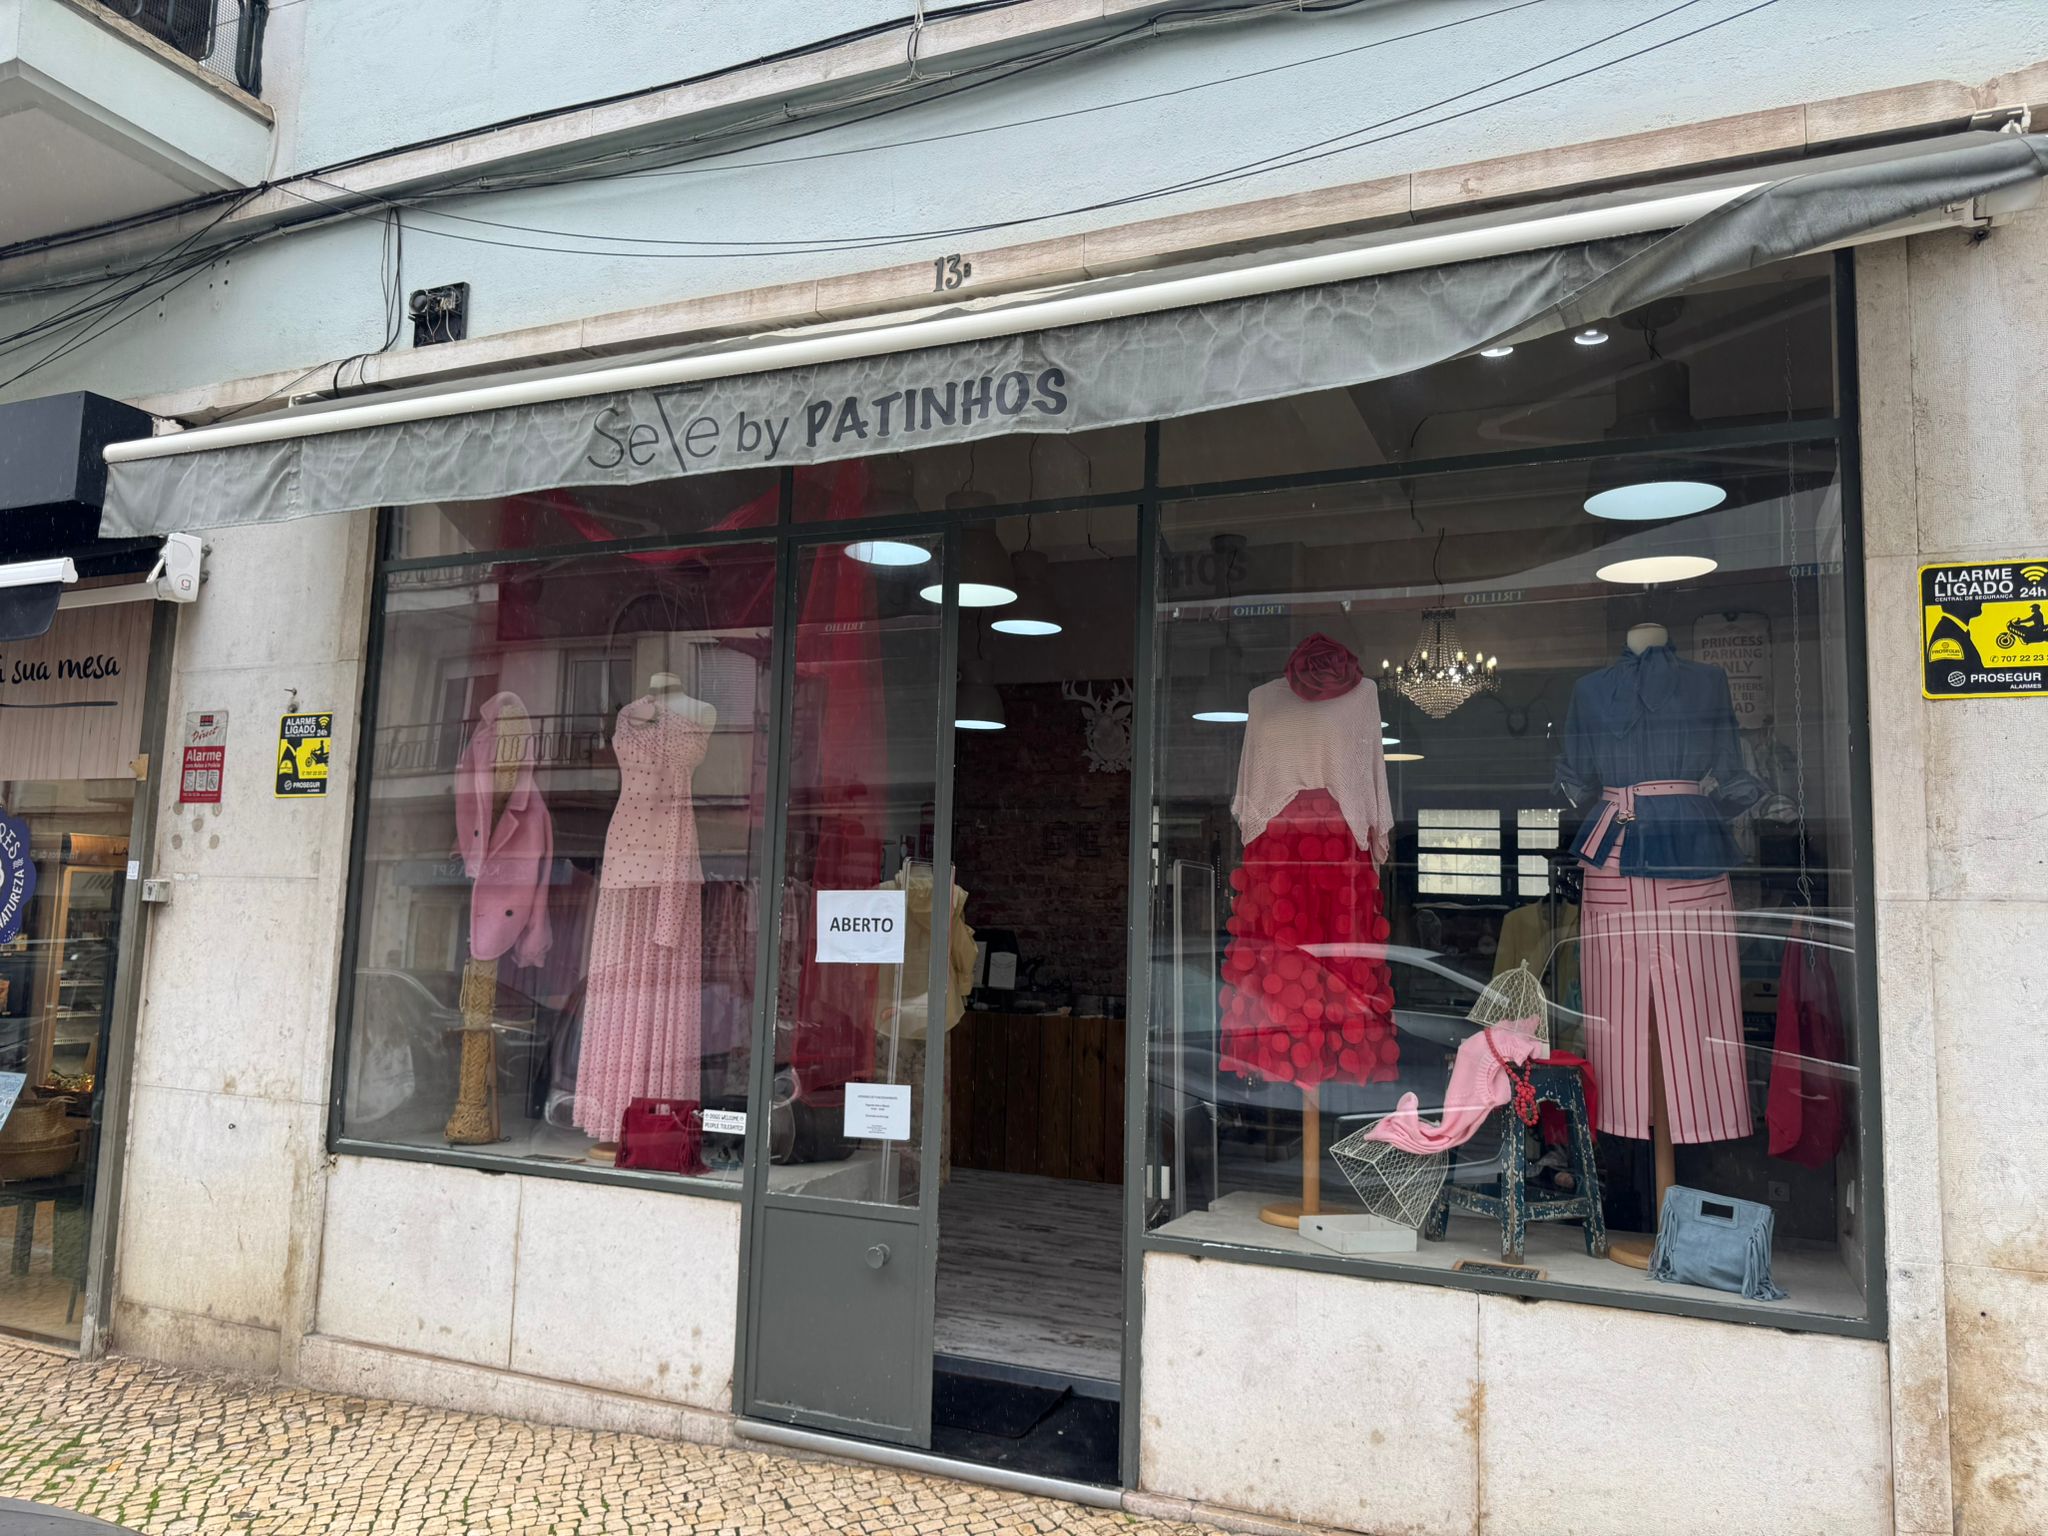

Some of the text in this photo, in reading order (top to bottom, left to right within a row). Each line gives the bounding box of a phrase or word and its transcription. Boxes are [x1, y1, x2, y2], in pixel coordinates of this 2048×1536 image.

[736, 410, 790, 461] by
[806, 367, 1068, 447] PATINHOS
[1935, 567, 2013, 584] ALARME
[1934, 580, 2014, 597] LIGADO
[2020, 586, 2047, 598] 24h
[1702, 636, 1763, 648] PRINCESS
[1703, 648, 1762, 661] PARKING
[2001, 655, 2017, 663] 707
[2033, 654, 2044, 662] 23
[11, 660, 52, 684] sua
[58, 654, 121, 680] mesa
[1970, 673, 2042, 683] PROSEGUR
[286, 717, 317, 726] ALARME
[285, 725, 316, 735] LIGADO
[186, 749, 222, 762] Alarme
[293, 781, 320, 789] PROSEGUR
[830, 917, 894, 933] ABERTO
